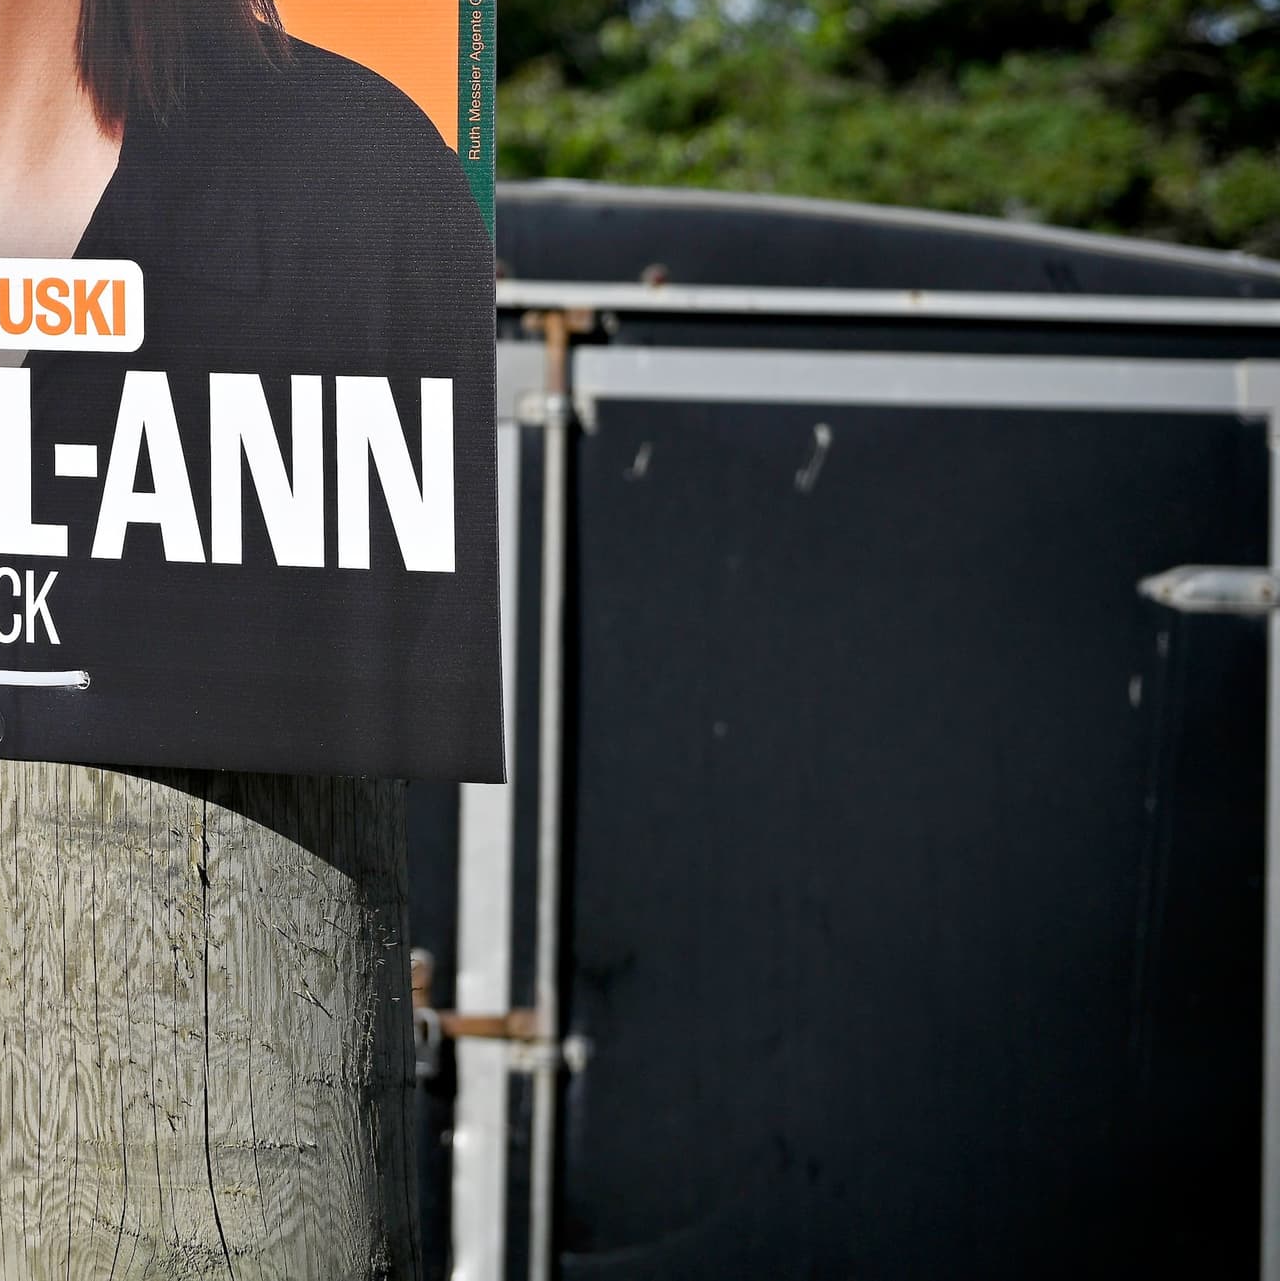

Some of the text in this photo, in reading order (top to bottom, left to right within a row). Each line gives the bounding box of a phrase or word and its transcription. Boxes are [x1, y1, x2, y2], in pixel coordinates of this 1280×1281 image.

[469, 10, 485, 61] Agente
[468, 65, 482, 122] Messier
[468, 125, 481, 160] Ruth
